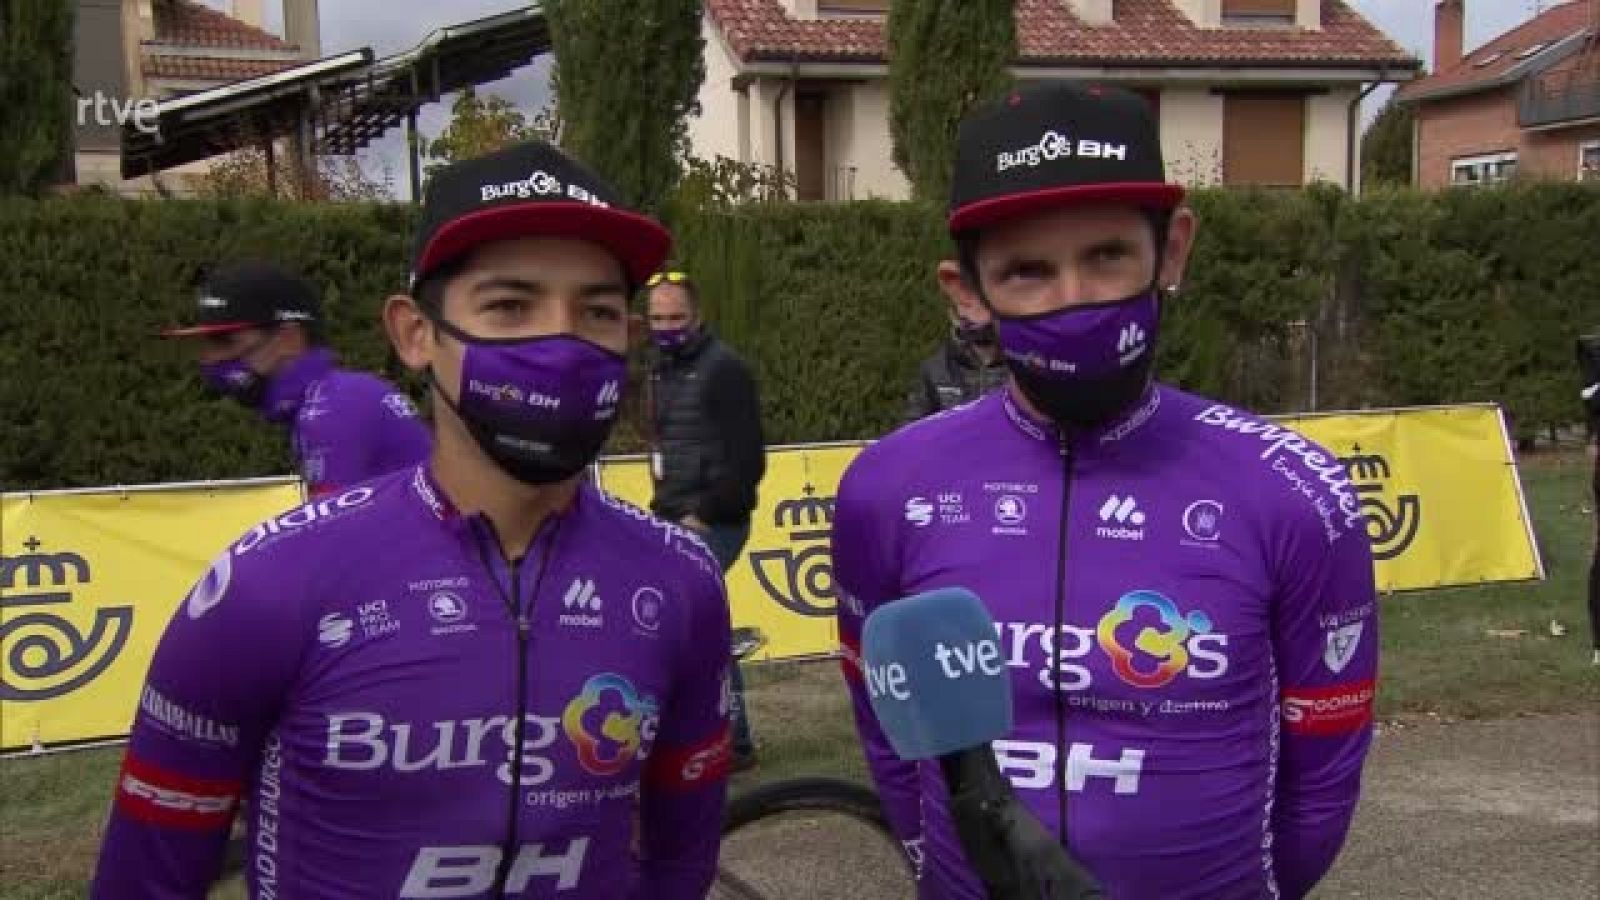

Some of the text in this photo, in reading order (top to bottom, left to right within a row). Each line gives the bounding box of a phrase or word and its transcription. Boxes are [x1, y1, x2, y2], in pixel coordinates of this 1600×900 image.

[997, 130, 1127, 172] Burgos BH
[480, 169, 562, 202] Burgos
[527, 392, 562, 409] BH
[1097, 526, 1144, 541] mobel
[559, 613, 602, 628] mobel
[934, 638, 1003, 678] tve
[991, 739, 1146, 793] BH
[525, 788, 592, 809] origen
[399, 837, 591, 899] BH
